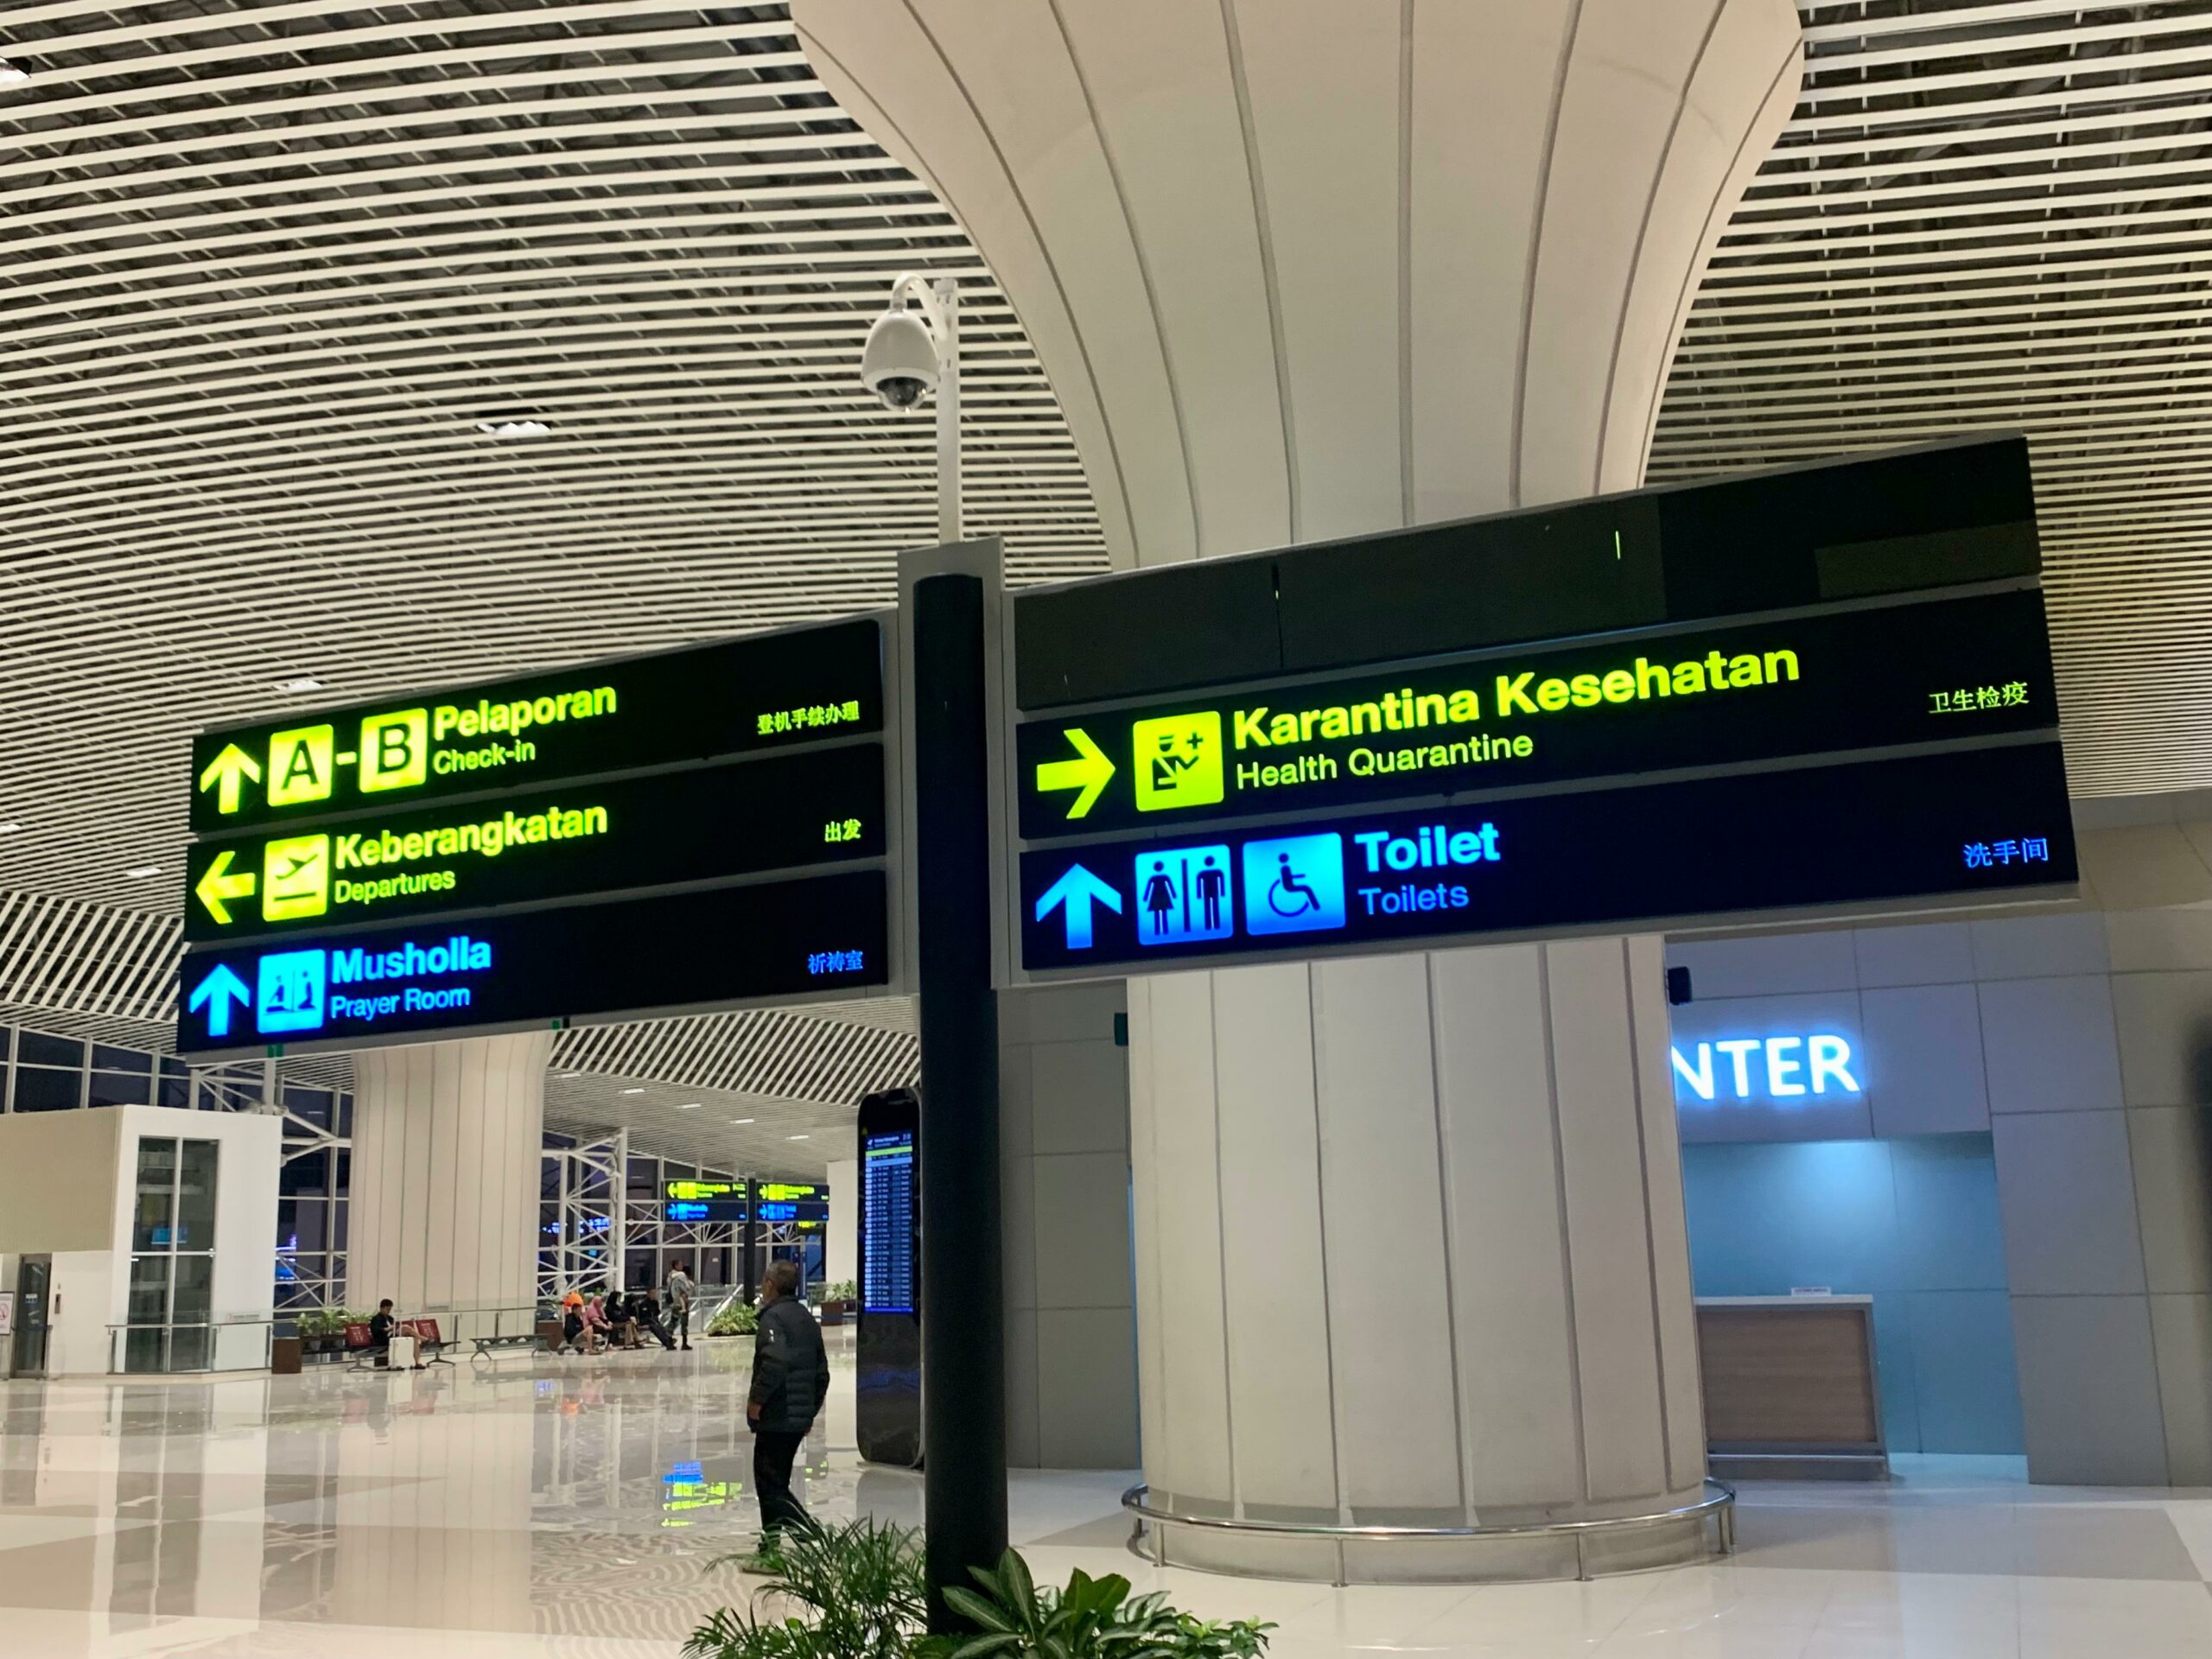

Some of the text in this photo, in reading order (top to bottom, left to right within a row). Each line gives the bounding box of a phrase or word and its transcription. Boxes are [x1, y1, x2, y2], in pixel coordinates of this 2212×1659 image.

[434, 686, 616, 741] Pelaporan
[1234, 649, 1799, 749] Karantina Kesehatan
[1929, 681, 2029, 713] 卫生检疫
[757, 701, 860, 734] 登机手续办理
[433, 740, 536, 774] Check-in
[1236, 734, 1533, 789] Health Quarantine
[334, 806, 607, 869] Keberangkatan
[825, 818, 861, 842] 出发
[1353, 822, 1501, 874] Toilet
[1963, 837, 2049, 868] 洗手间
[334, 870, 455, 905] Departures
[1357, 882, 1470, 915] Toilets
[332, 935, 492, 983] Musholla
[808, 950, 863, 975] 祈祷室
[330, 987, 471, 1020] Prayer Room
